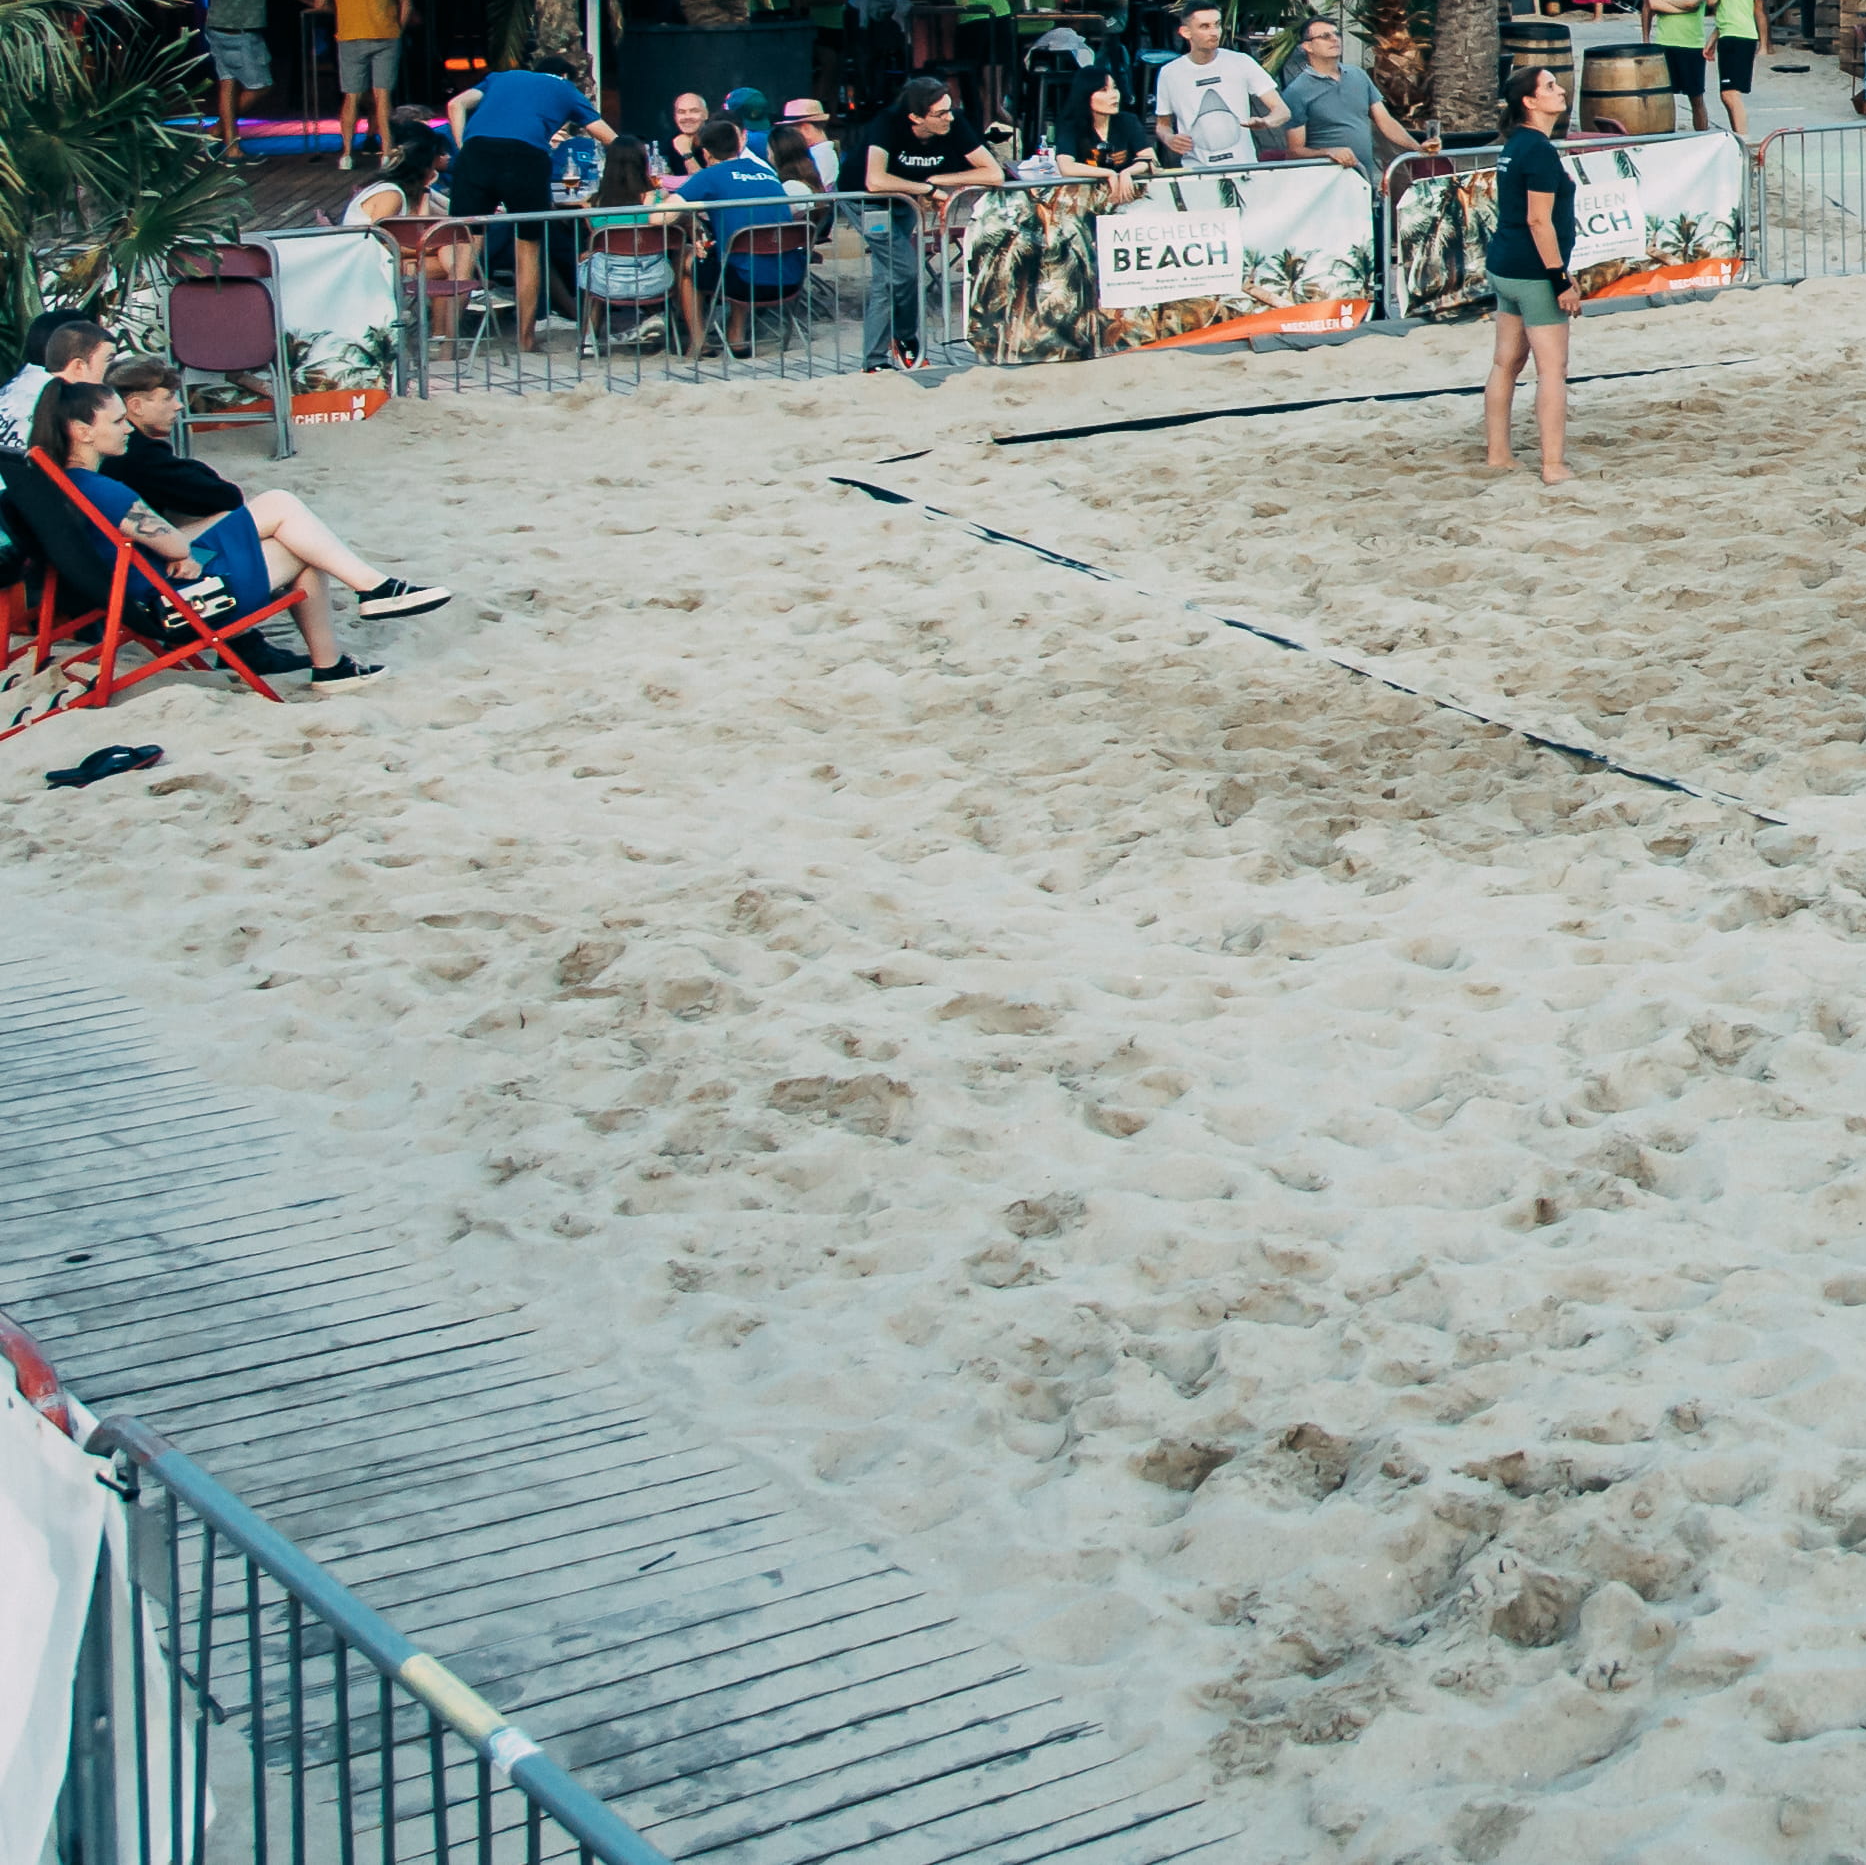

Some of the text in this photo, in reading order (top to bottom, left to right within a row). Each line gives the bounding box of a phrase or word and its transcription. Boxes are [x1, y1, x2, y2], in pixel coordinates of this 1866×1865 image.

[1113, 222, 1225, 243] MECHELEN
[1575, 209, 1633, 238] ACH
[1113, 240, 1229, 272] BEACH
[294, 411, 351, 426] CHELEN
